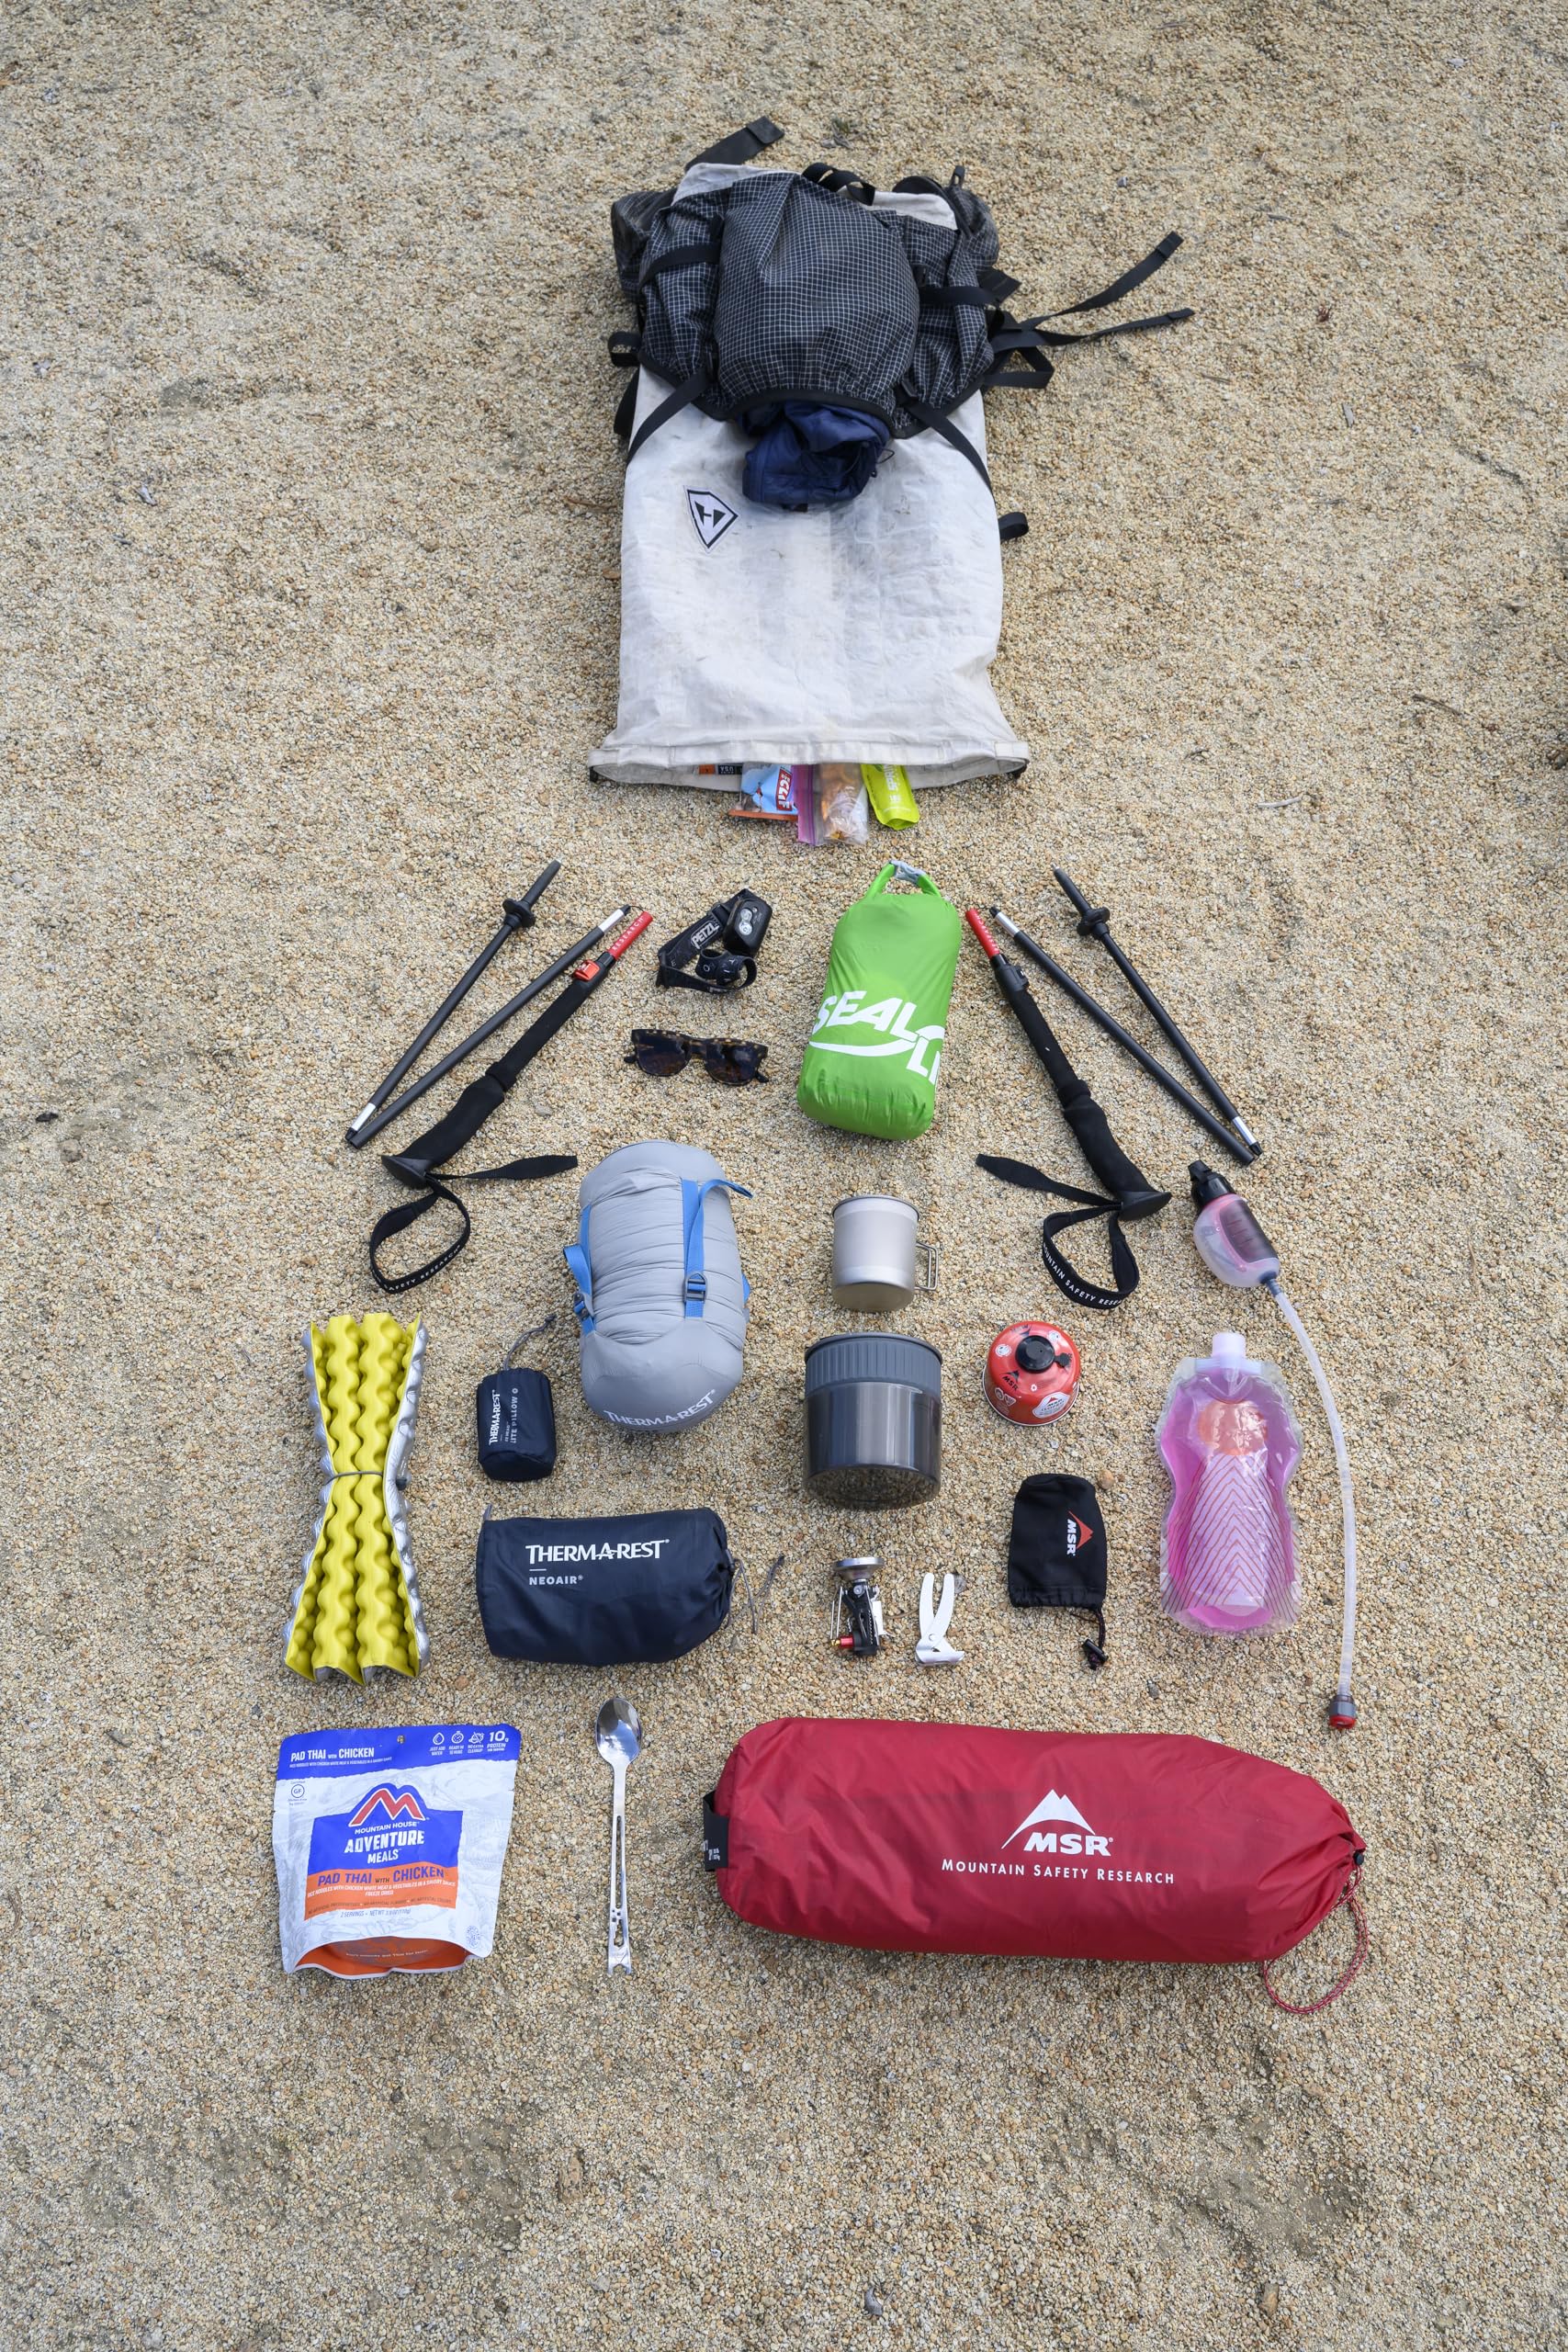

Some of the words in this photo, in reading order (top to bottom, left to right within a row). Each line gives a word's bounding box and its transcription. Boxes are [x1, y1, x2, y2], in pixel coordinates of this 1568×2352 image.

[778, 779, 790, 808] CLIF
[611, 917, 645, 950] RESEARCH
[691, 922, 720, 949] PETZL
[1066, 1280, 1096, 1302] SAFETY
[1002, 1375, 1019, 1392] MSR
[510, 1428, 518, 1444] LITE
[1066, 1519, 1077, 1555] MSR
[290, 1751, 306, 1762] PAD
[308, 1749, 326, 1759] THAI
[339, 1747, 375, 1758] CHICKEN
[355, 1824, 390, 1835] MOUNTAIN
[344, 1830, 424, 1854] ADVENTURE
[1023, 1832, 1111, 1856] MSR
[367, 1849, 399, 1864] MEALS
[317, 1873, 341, 1886] PAD
[344, 1872, 372, 1883] THAI
[392, 1866, 445, 1883] CHICKEN
[942, 1859, 1025, 1876] MOUNTAIN
[1033, 1864, 1089, 1880] SAFETY
[1097, 1868, 1175, 1884] RESEARCH
